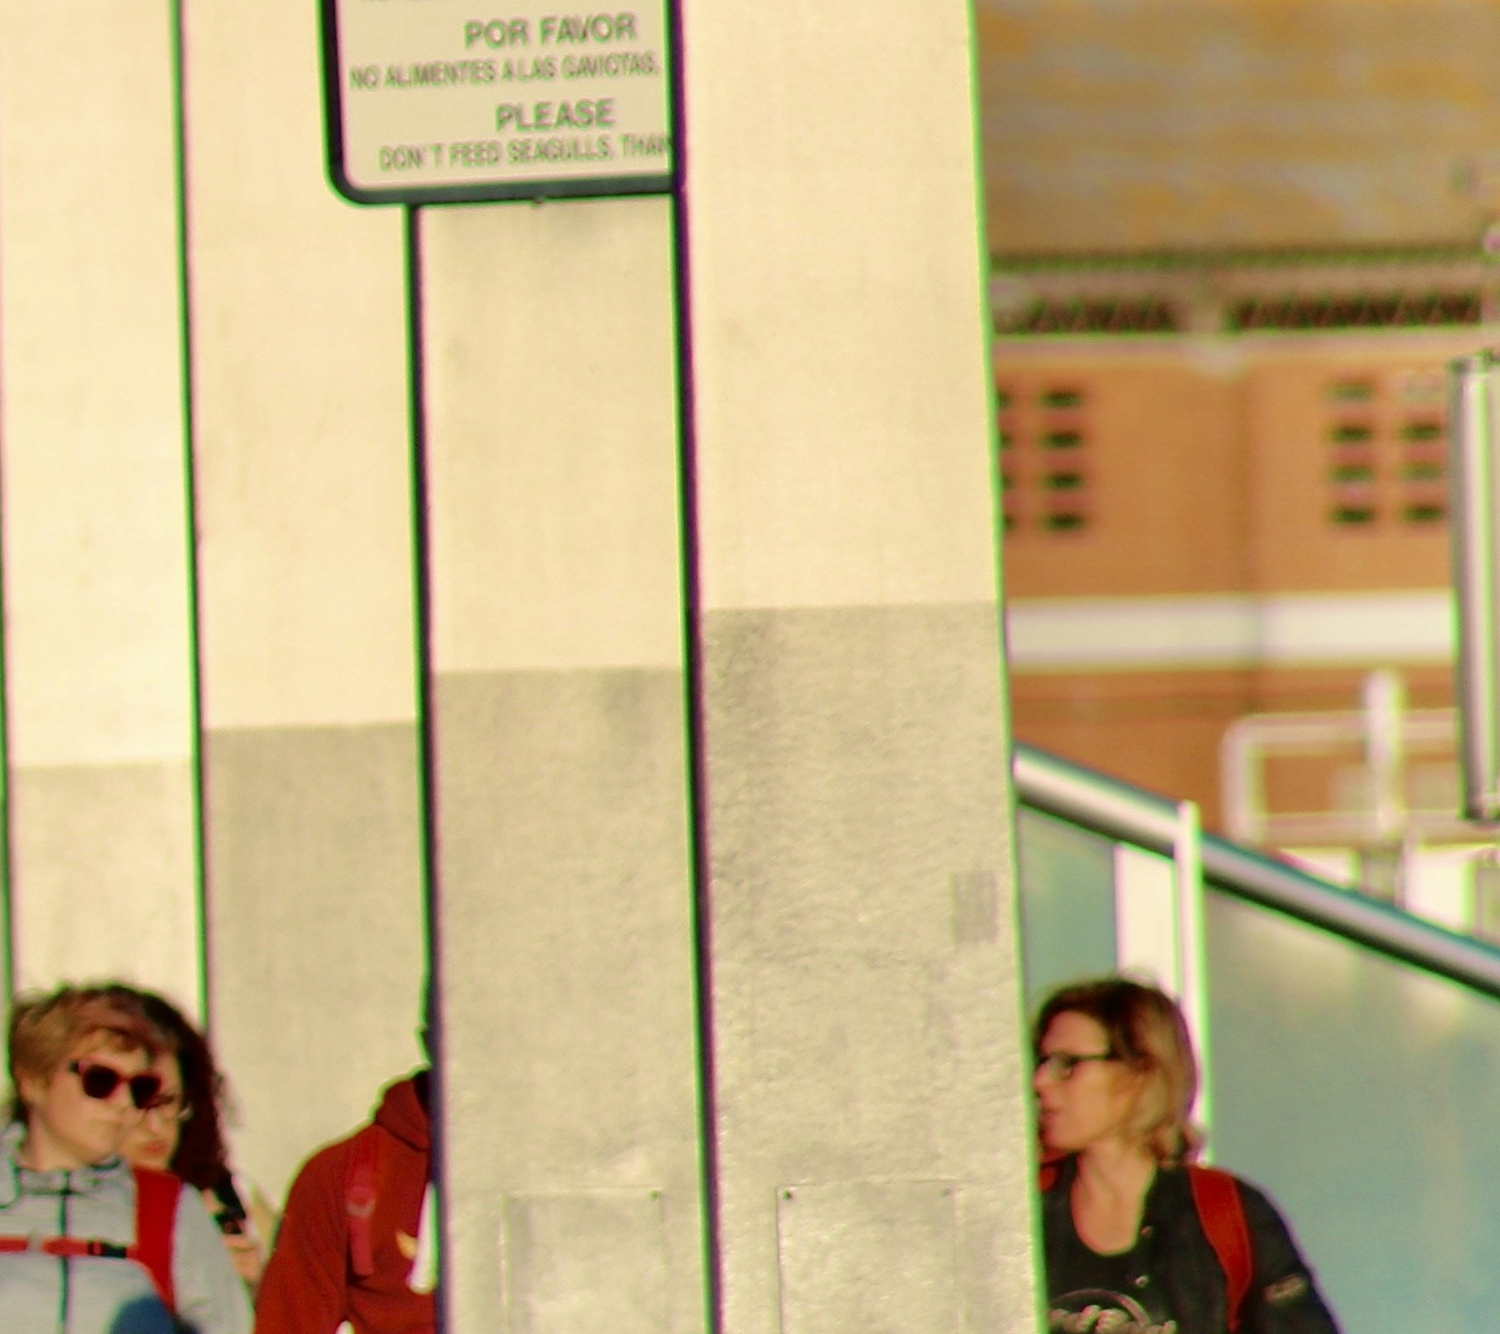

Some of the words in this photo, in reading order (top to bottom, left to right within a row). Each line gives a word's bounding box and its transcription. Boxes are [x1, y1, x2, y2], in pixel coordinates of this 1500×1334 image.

[463, 20, 529, 49] POR
[540, 13, 636, 45] FAVOR
[349, 66, 379, 90] NO
[384, 60, 496, 88] ALIMENTES
[517, 55, 555, 81] LAS
[495, 98, 617, 133] PLEASE
[449, 141, 500, 168] FEED
